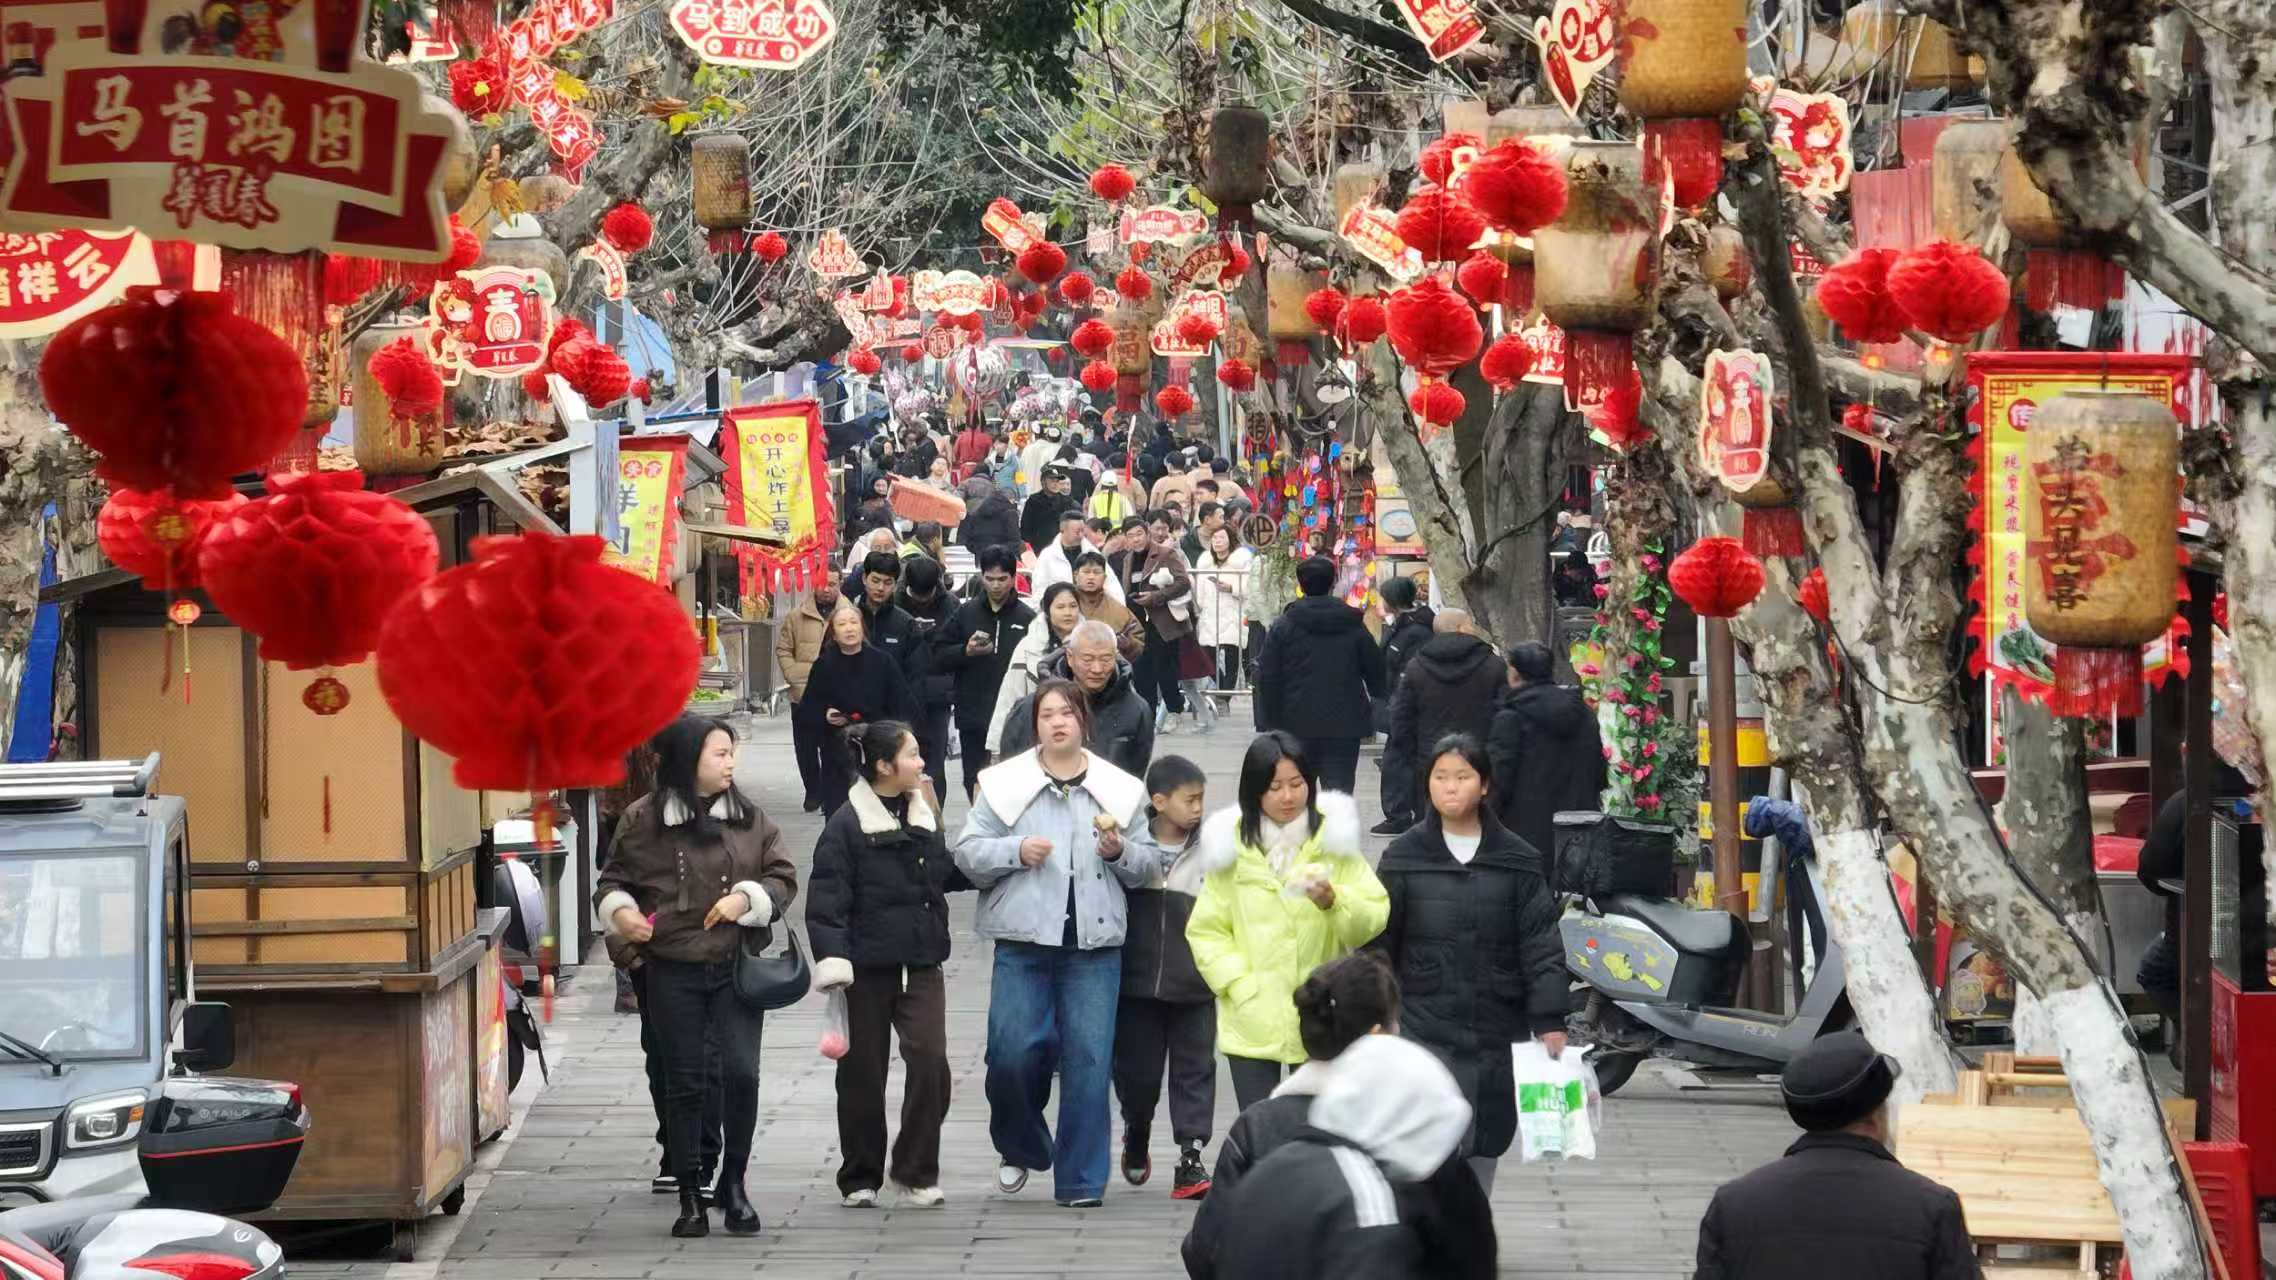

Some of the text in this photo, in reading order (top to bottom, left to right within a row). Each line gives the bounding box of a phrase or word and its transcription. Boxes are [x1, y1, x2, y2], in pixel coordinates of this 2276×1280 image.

[686, 2, 821, 39] 马到成功
[76, 74, 367, 174] 马首鸿图
[0, 241, 111, 305] 祥云
